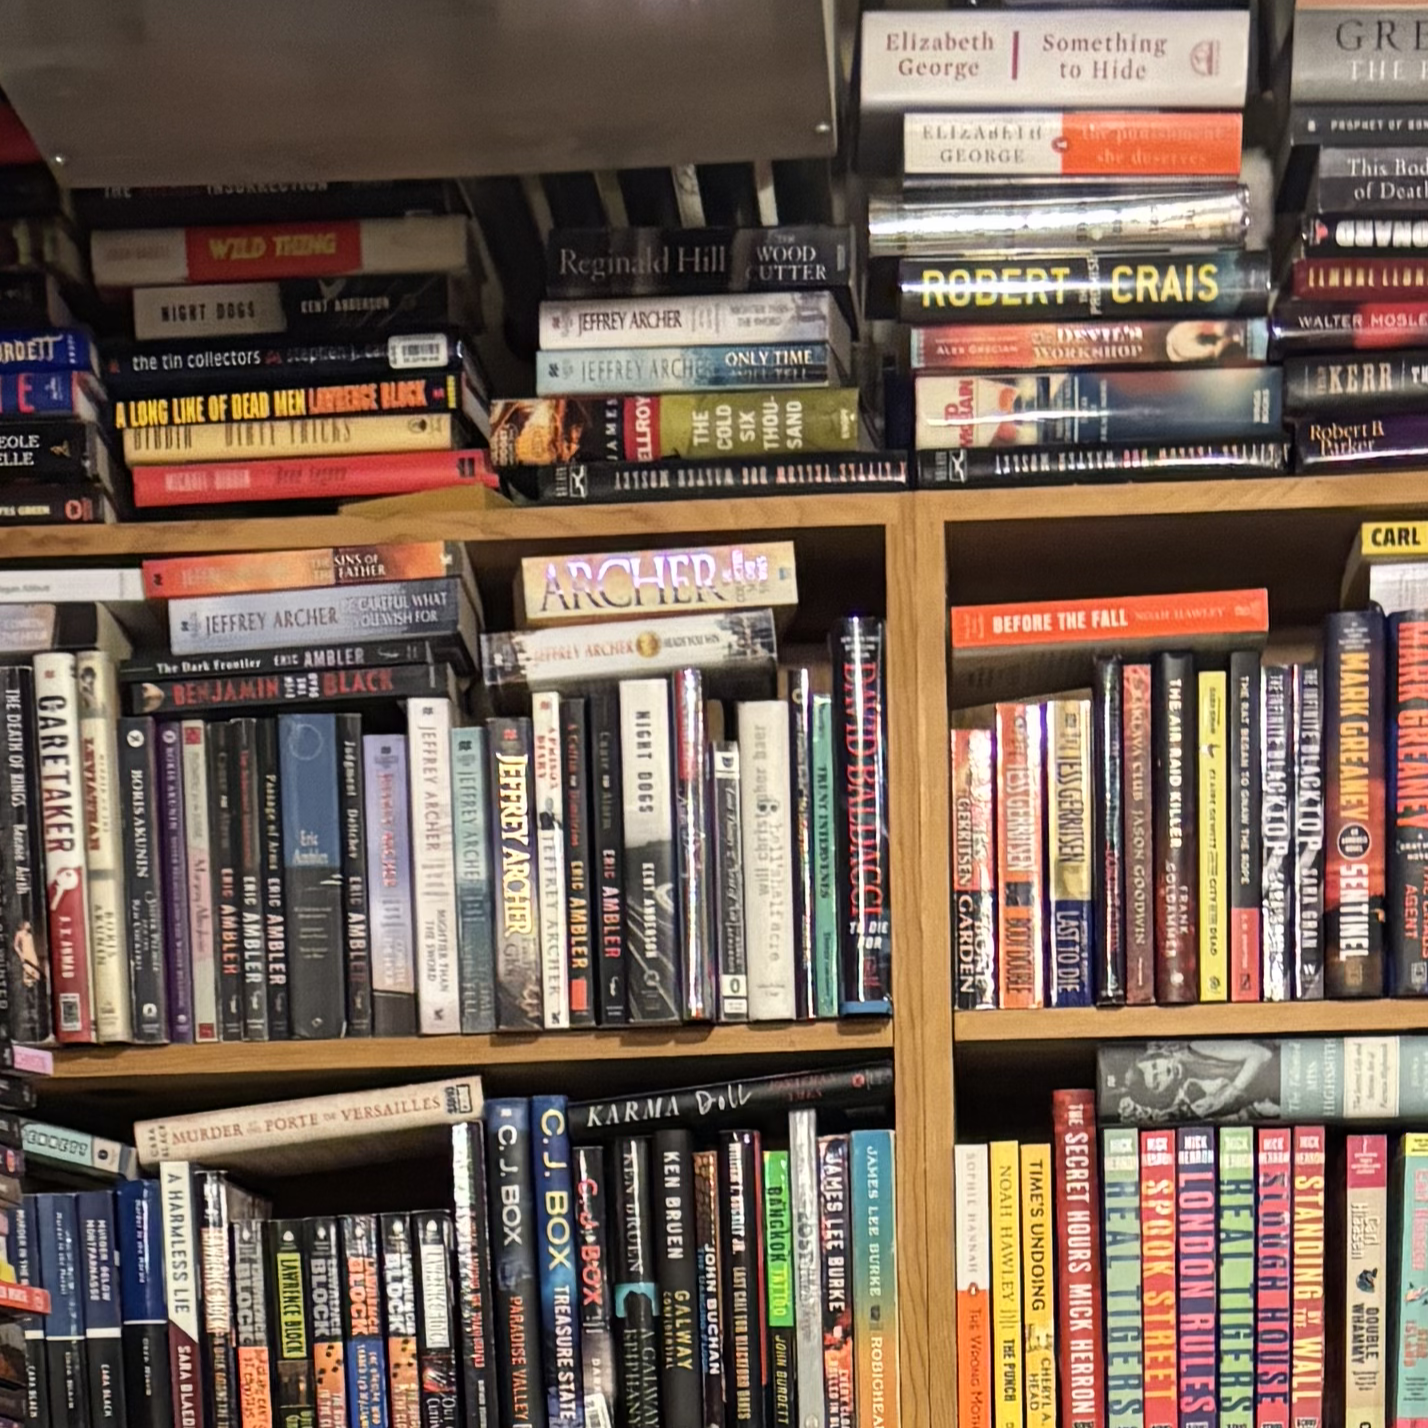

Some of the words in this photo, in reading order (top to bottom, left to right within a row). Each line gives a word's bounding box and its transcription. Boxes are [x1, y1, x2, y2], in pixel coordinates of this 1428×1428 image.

[885, 32, 995, 53] Elizabeth
[1042, 32, 1168, 58] Something
[898, 56, 980, 79] George
[1060, 60, 1085, 79] to
[1093, 58, 1147, 79] Hide
[1347, 158, 1388, 176] This
[1354, 182, 1373, 200] of
[559, 249, 670, 280] Reginald
[677, 246, 726, 273] Hill
[922, 269, 1070, 307] ROBERT
[1111, 264, 1219, 304] CRAIS
[1298, 312, 1363, 328] WALTER
[1371, 526, 1421, 546] CARL
[541, 554, 726, 613] ARCHER
[205, 613, 267, 635] JEFFREY
[273, 607, 337, 629] ARCHER
[992, 613, 1053, 633] BEFORE
[1058, 611, 1088, 630] THE
[1092, 609, 1128, 628] FALL
[1340, 653, 1370, 719] MARK
[1341, 724, 1370, 821] GREANEY
[1340, 863, 1369, 961] SENTINEL
[172, 1122, 243, 1145] MURDER
[265, 1112, 318, 1134] PORTE
[342, 1096, 441, 1122] VERSAILLES
[586, 1095, 680, 1127] KARMA
[1066, 1103, 1084, 1125] THE
[663, 1152, 680, 1189] KEN
[1063, 1132, 1090, 1204] SECRET
[665, 1197, 683, 1259] BRUEN
[1066, 1210, 1090, 1273] HOURS
[1179, 1173, 1214, 1290] LONDON
[1029, 1215, 1045, 1311] UNDOING
[553, 1285, 572, 1373] TREASURE
[1068, 1284, 1093, 1333] MICK
[1070, 1339, 1095, 1414] HERRON
[1182, 1315, 1215, 1413] RULES
